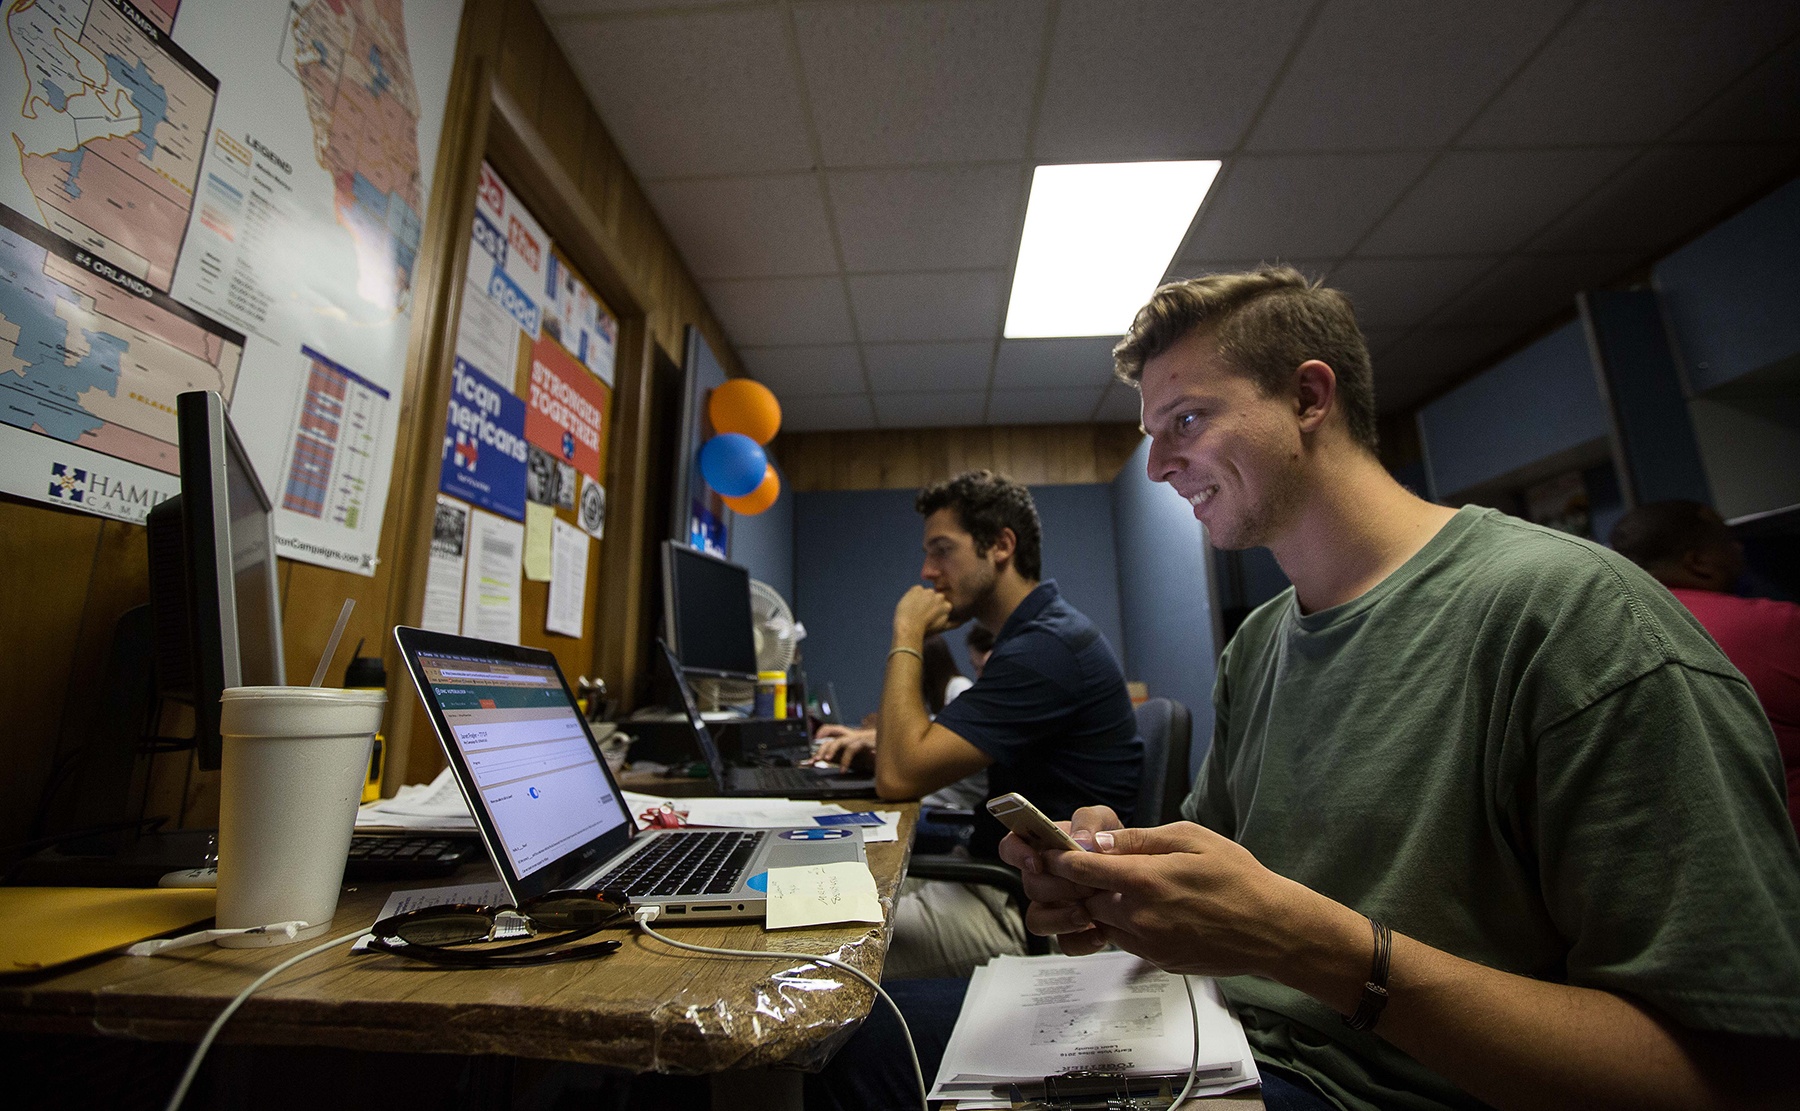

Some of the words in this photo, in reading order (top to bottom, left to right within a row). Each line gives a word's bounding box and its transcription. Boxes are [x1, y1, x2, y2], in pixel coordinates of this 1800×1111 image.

[122, 4, 159, 41] TAMPA
[245, 133, 293, 175] LEGEND
[75, 251, 92, 267] #4
[92, 261, 154, 298] ORLANDO
[530, 383, 600, 453] TOGETHER
[532, 360, 602, 432] STRONGER
